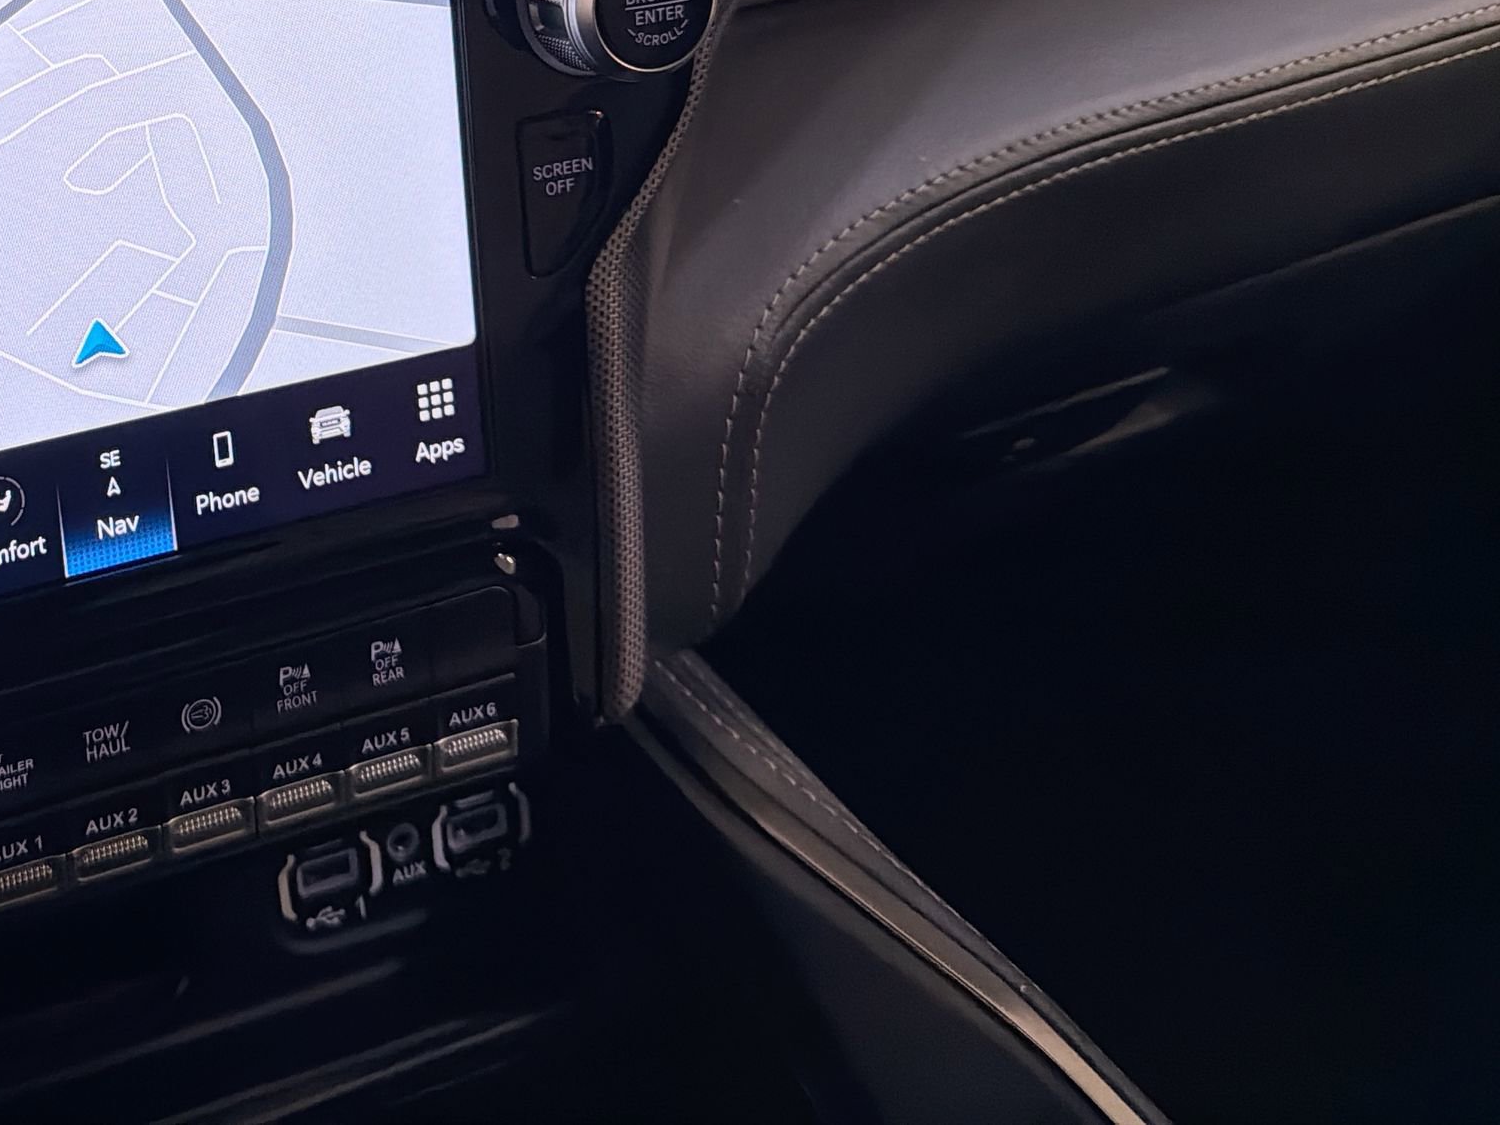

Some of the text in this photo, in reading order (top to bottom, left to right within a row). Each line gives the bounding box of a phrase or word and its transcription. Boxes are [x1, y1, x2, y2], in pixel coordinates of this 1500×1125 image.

[634, 5, 685, 27] ENTER
[634, 26, 684, 47] SCROLL
[532, 157, 594, 181] SCREEN
[545, 178, 575, 196] OFF
[100, 449, 122, 470] SE
[415, 437, 466, 465] Apps
[297, 456, 372, 491] Vehicle
[195, 484, 261, 516] Phone
[97, 514, 140, 541] Nav
[372, 666, 404, 687] REAR
[375, 656, 398, 672] OFF
[283, 679, 308, 697] OFF
[276, 690, 318, 715] FRONT
[449, 701, 497, 727] AUX 6
[83, 720, 130, 747] TOW/
[361, 727, 410, 754] AUX 5
[85, 737, 131, 763] HAUL
[272, 752, 323, 780] AUX 4
[179, 778, 231, 806] AUX 3
[85, 807, 139, 835] AUX 2
[34, 835, 43, 851] 1
[392, 860, 428, 884] AUX
